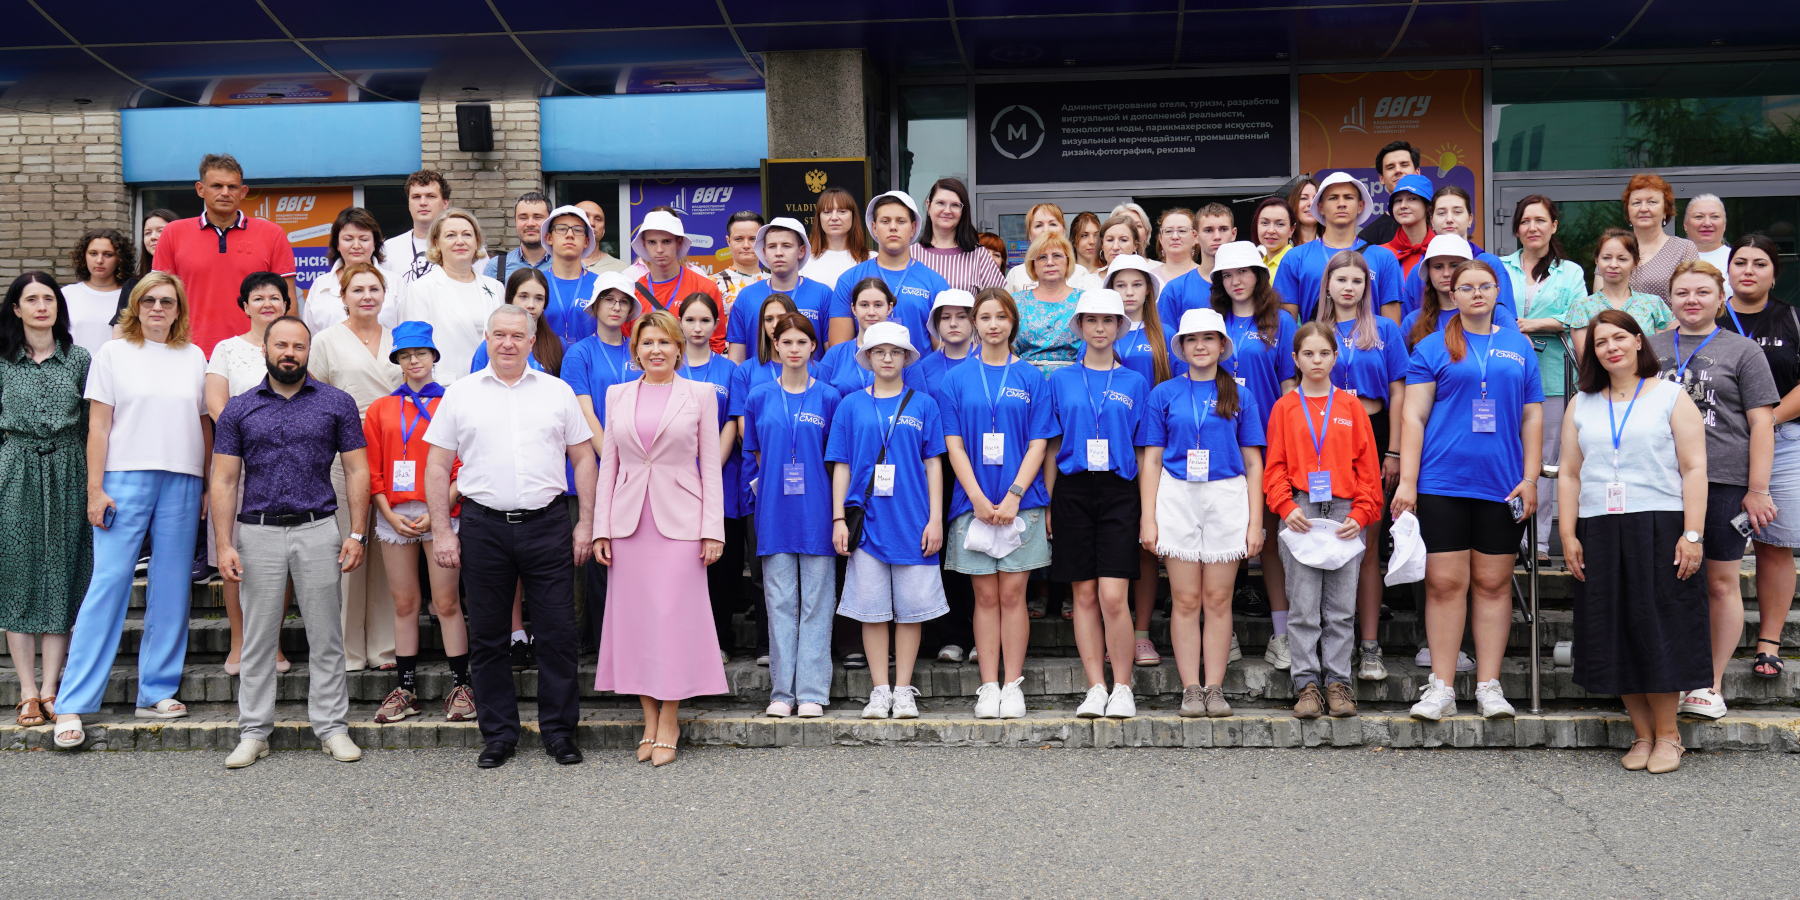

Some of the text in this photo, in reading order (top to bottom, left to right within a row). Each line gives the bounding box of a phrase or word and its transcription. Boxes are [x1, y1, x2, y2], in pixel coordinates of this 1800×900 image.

[1061, 97, 1280, 112] Администрирование отеля, туризм, разработка
[1374, 95, 1432, 118] ВВГУ
[1061, 113, 1120, 124] виртуальной
[1130, 111, 1187, 122] дополненой
[1189, 110, 1245, 120] реальности,
[1061, 121, 1274, 134] технологии моды, парикмахерское искусство,
[1061, 132, 1270, 146] визуальный мерчендайзинг, промышленный
[1156, 146, 1196, 155] реклама
[692, 186, 733, 204] ВВГУ
[275, 195, 317, 213] ВВГУ
